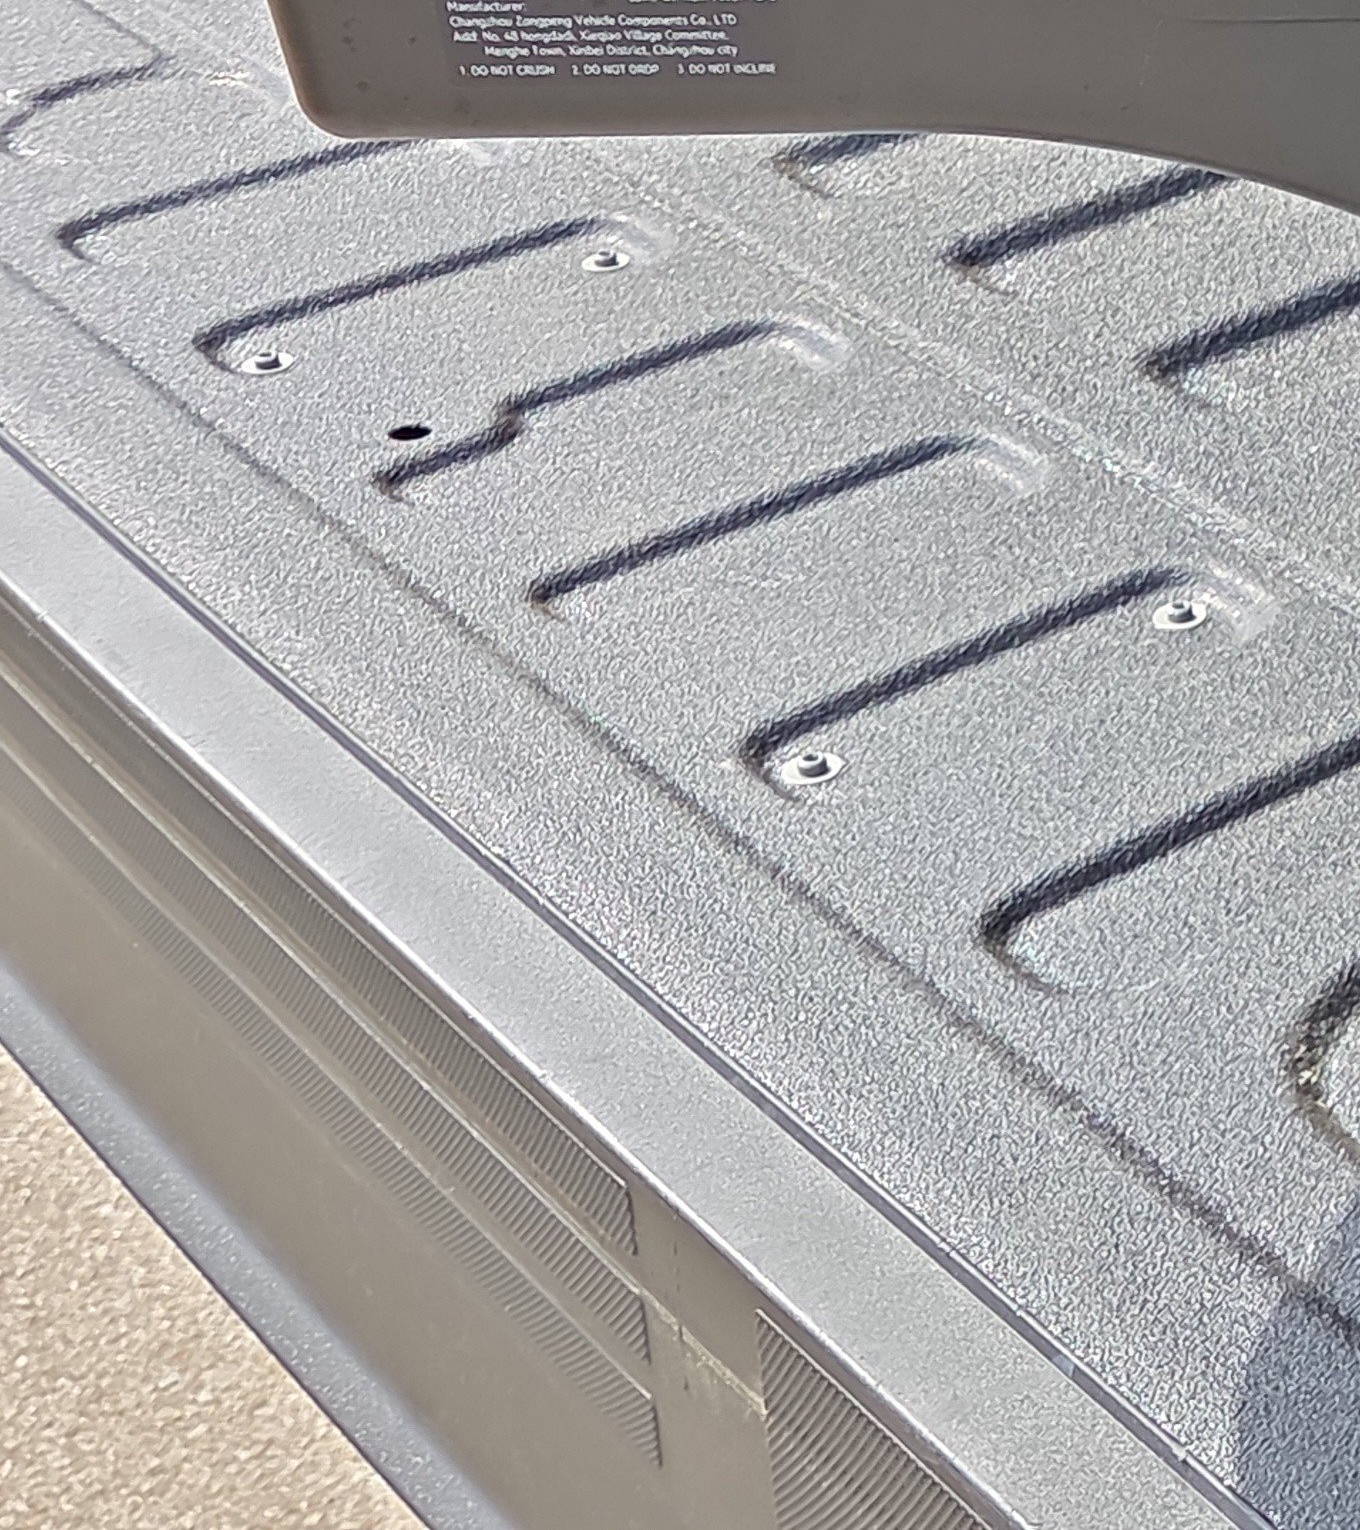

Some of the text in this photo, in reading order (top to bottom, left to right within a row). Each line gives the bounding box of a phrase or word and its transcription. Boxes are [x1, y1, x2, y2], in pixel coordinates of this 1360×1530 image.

[574, 15, 615, 26] Vehicle
[618, 14, 688, 26] Components
[624, 30, 662, 42] Village
[470, 65, 488, 76] DO
[491, 65, 513, 75] NOT
[583, 64, 601, 76] DO
[603, 64, 624, 76] NOT
[687, 63, 705, 75] DO
[708, 63, 731, 75] NOT
